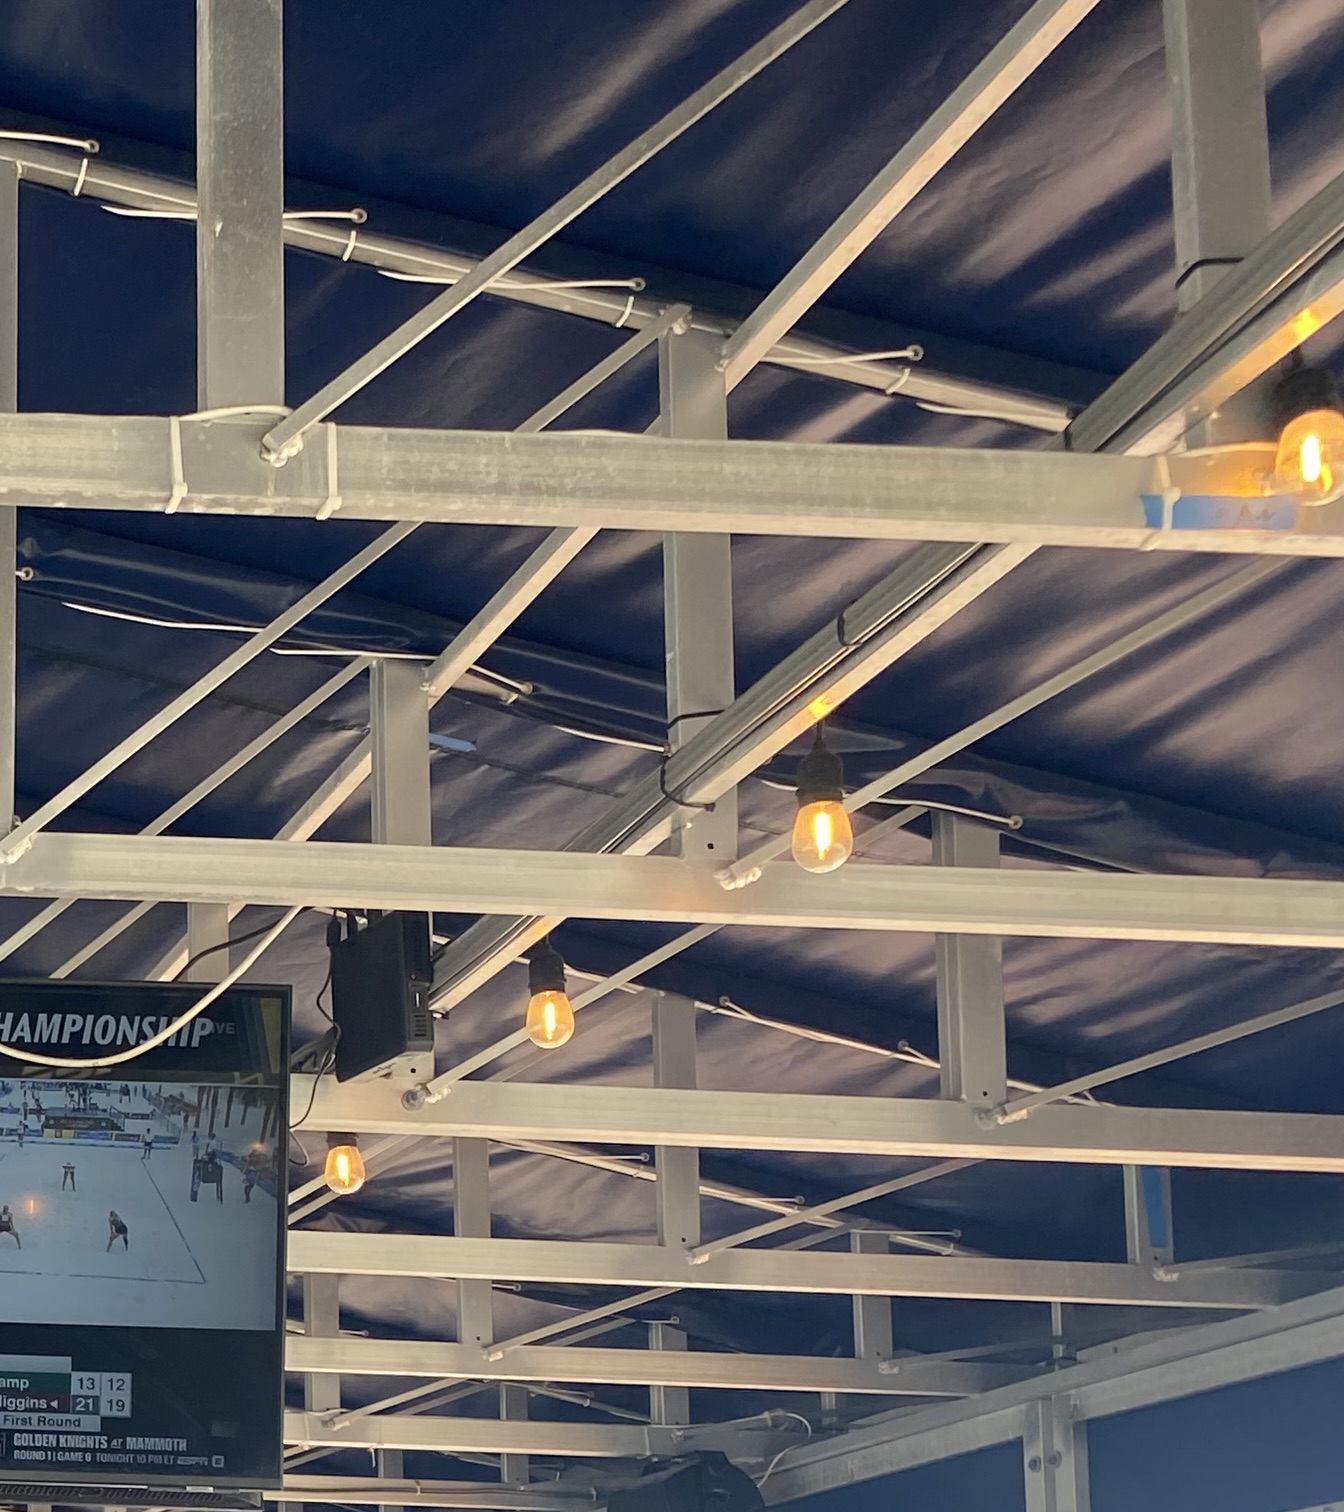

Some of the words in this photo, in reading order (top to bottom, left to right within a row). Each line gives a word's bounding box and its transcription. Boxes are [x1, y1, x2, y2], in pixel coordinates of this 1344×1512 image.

[77, 1377, 96, 1391] 13
[107, 1378, 126, 1392] 12
[75, 1397, 94, 1412] 21
[107, 1399, 125, 1413] 19
[2, 1414, 33, 1427] First
[37, 1415, 81, 1428] Round
[13, 1432, 57, 1448] GOLDEN
[58, 1433, 108, 1449] KNIGHTS
[126, 1436, 188, 1452] MAMMOTH
[13, 1450, 46, 1461] ROUND
[57, 1451, 85, 1462] GAME
[95, 1452, 135, 1464] TONIGHT
